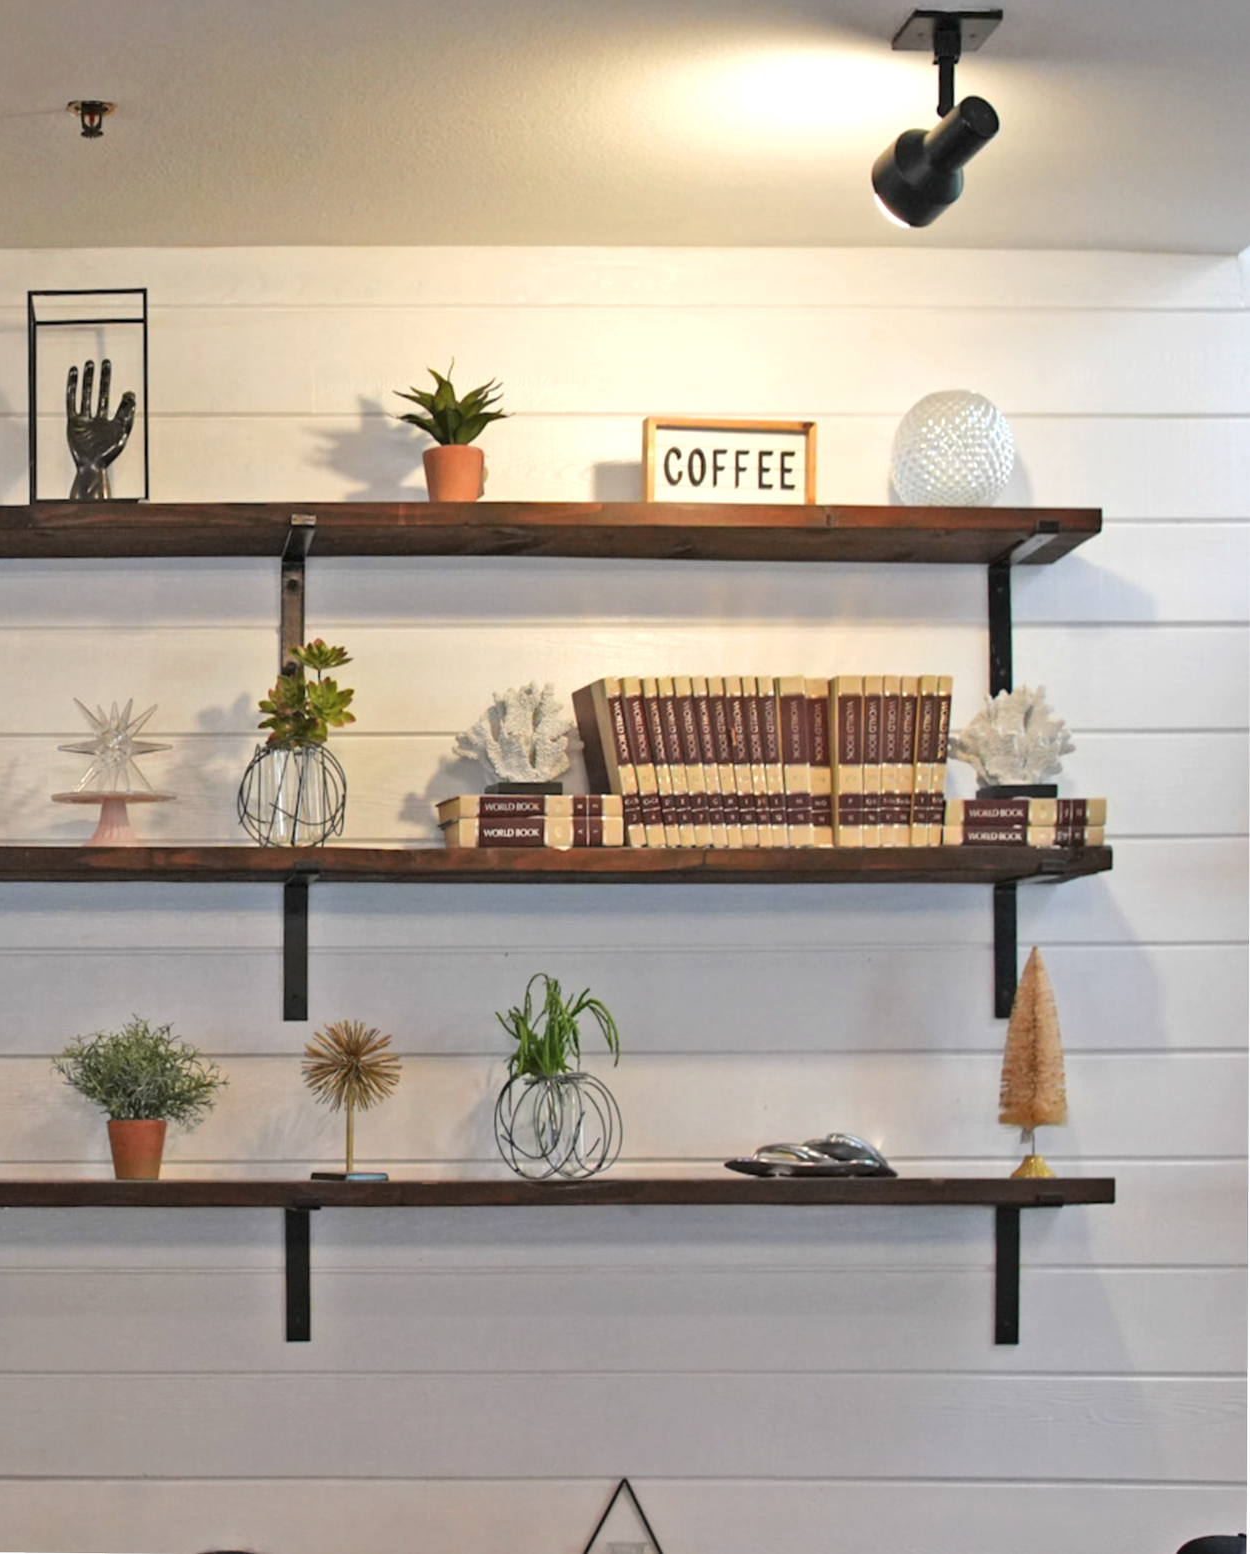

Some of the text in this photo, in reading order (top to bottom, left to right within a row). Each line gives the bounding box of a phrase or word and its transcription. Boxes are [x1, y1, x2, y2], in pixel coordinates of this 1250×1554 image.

[663, 446, 796, 490] COFFEE
[613, 701, 629, 760] WORLD BOOK
[632, 701, 647, 759] WORLD BOOK
[650, 701, 665, 760] WORLD BOOK
[666, 701, 680, 760] WORLD BOOK
[682, 701, 696, 759] WORLD BOOK
[699, 701, 713, 759] WORLD BOOK
[715, 701, 728, 759] WORLD BOOK
[733, 701, 745, 760] WORLD BOOK
[749, 701, 761, 760] WORLD BOOK
[765, 701, 776, 759] WORLD BOOK
[790, 701, 800, 759] WORLD BOOK
[814, 703, 823, 761] WORLD BOOK
[846, 701, 855, 760] WORLD BOOK
[869, 701, 877, 759] WORLD BOOK
[887, 701, 896, 759] WORLD BOOK
[902, 702, 912, 760] WORLD BOOK
[922, 701, 932, 759] WORLD BOOK
[937, 701, 949, 759] WORLD BOOK
[483, 828, 540, 838] WORLD BOOK
[484, 802, 540, 811] WORLD BOOK
[969, 808, 1024, 818] WORLD BOOK
[967, 831, 1023, 841] WORLD BOOK
